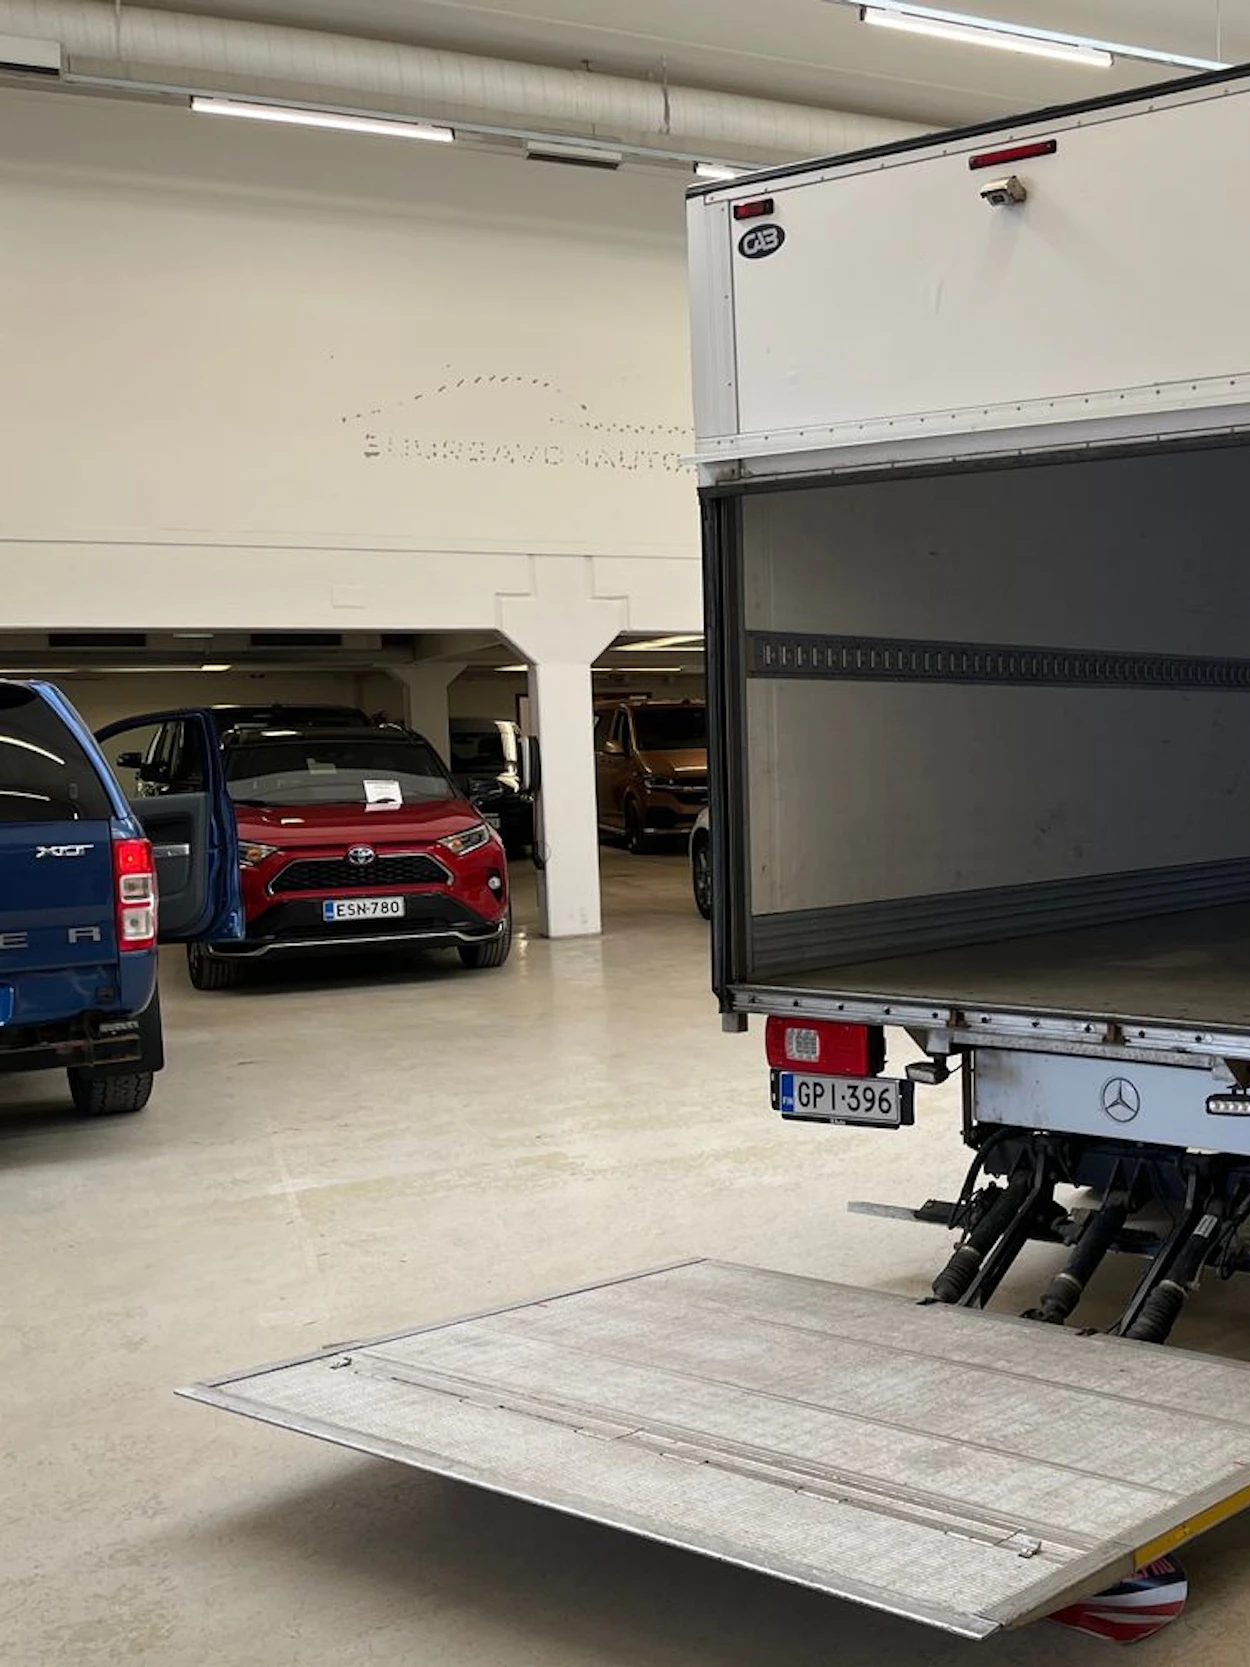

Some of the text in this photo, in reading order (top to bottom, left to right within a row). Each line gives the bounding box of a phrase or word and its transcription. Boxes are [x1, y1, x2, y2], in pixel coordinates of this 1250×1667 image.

[743, 228, 780, 255] CAB
[336, 901, 399, 917] ESN-780
[798, 1081, 892, 1114] GPI-396
